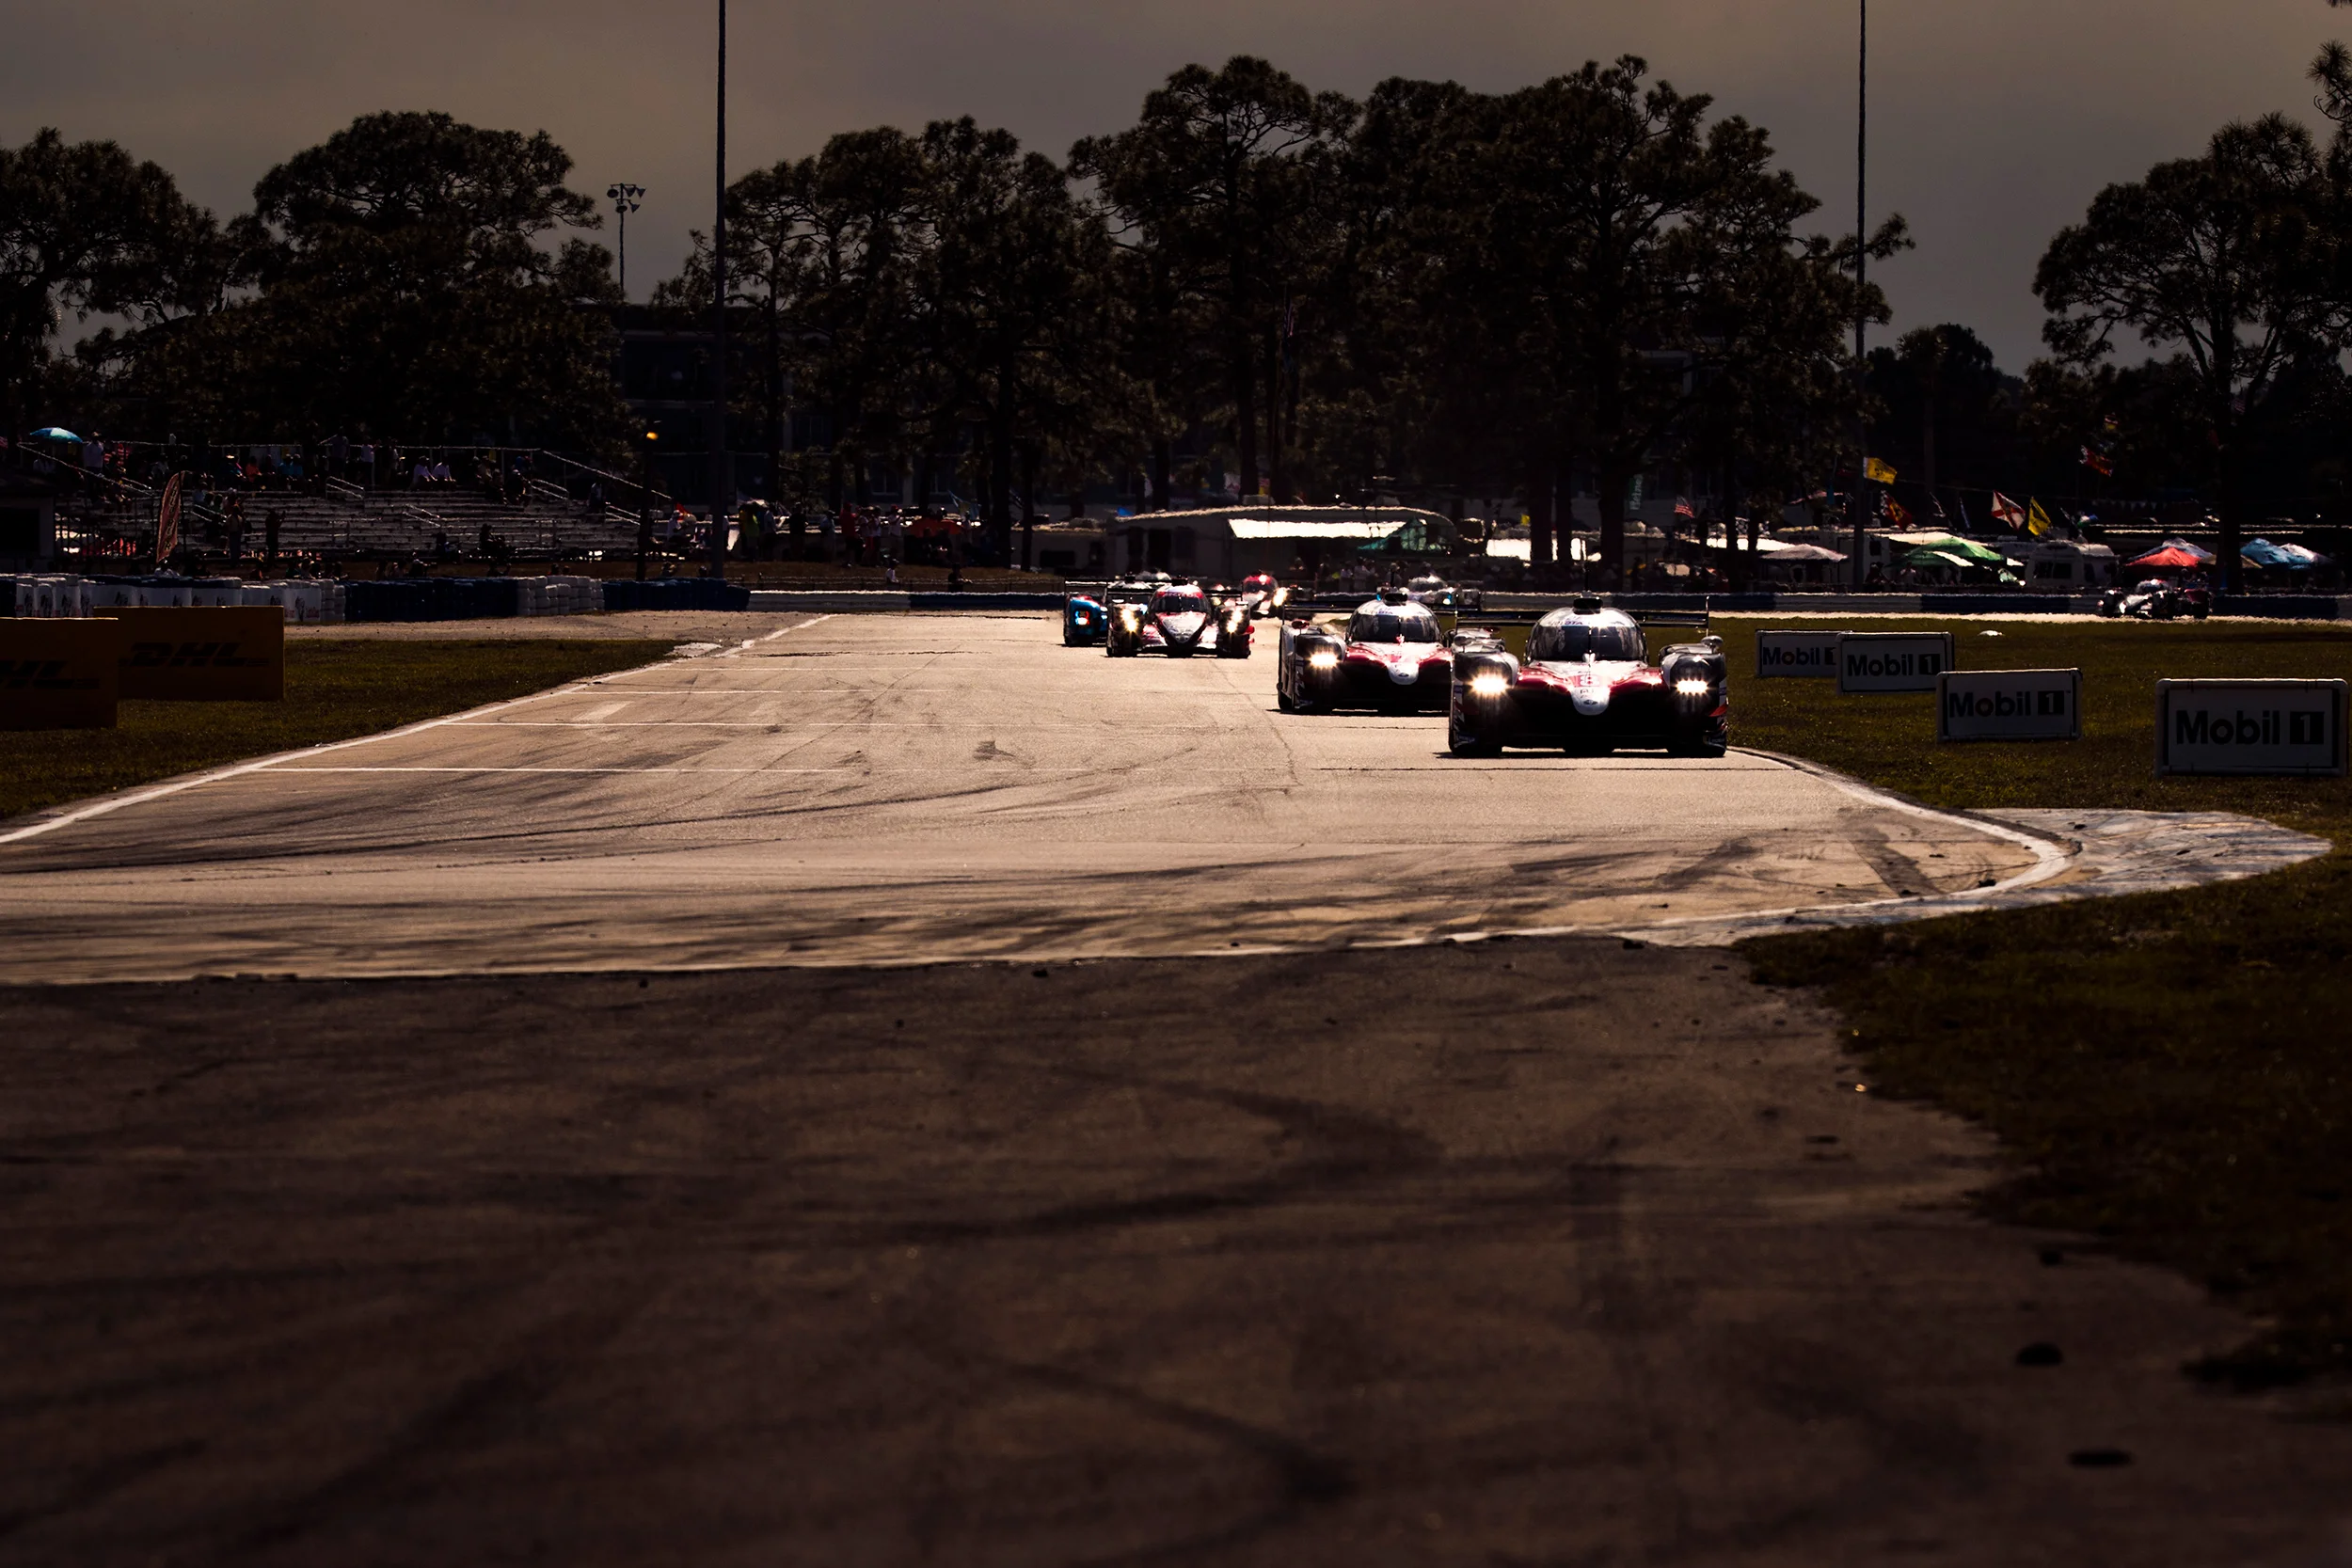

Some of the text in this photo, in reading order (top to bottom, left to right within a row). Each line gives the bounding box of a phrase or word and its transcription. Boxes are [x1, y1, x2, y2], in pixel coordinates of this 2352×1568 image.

[130, 641, 250, 668] DHL
[1762, 646, 1820, 666] Mobil
[1847, 654, 1914, 676] Mobil
[0, 659, 74, 689] HL
[1948, 690, 2032, 718] Mobil
[2175, 709, 2280, 745] Mobil
